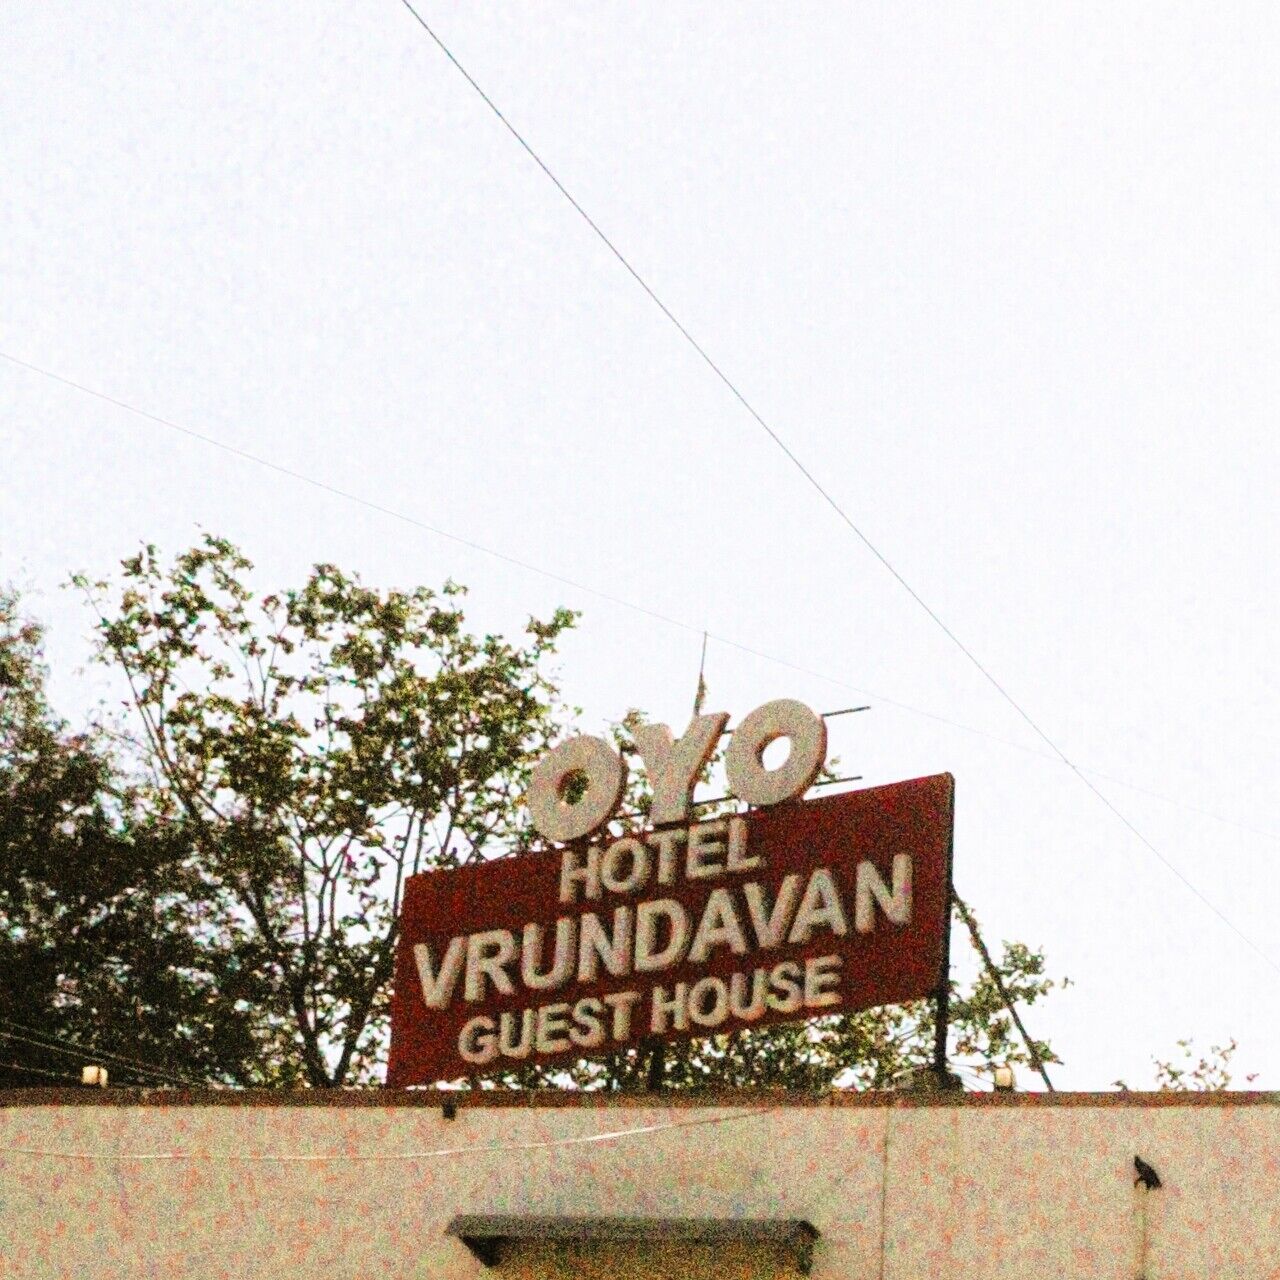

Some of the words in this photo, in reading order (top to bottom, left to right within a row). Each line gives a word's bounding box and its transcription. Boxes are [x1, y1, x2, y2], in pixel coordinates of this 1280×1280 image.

[527, 699, 826, 842] OYO
[559, 819, 762, 901] HOTEL
[414, 853, 915, 1009] VRUNDAVAN
[458, 992, 639, 1064] GUEST
[650, 955, 843, 1034] HOUSE
